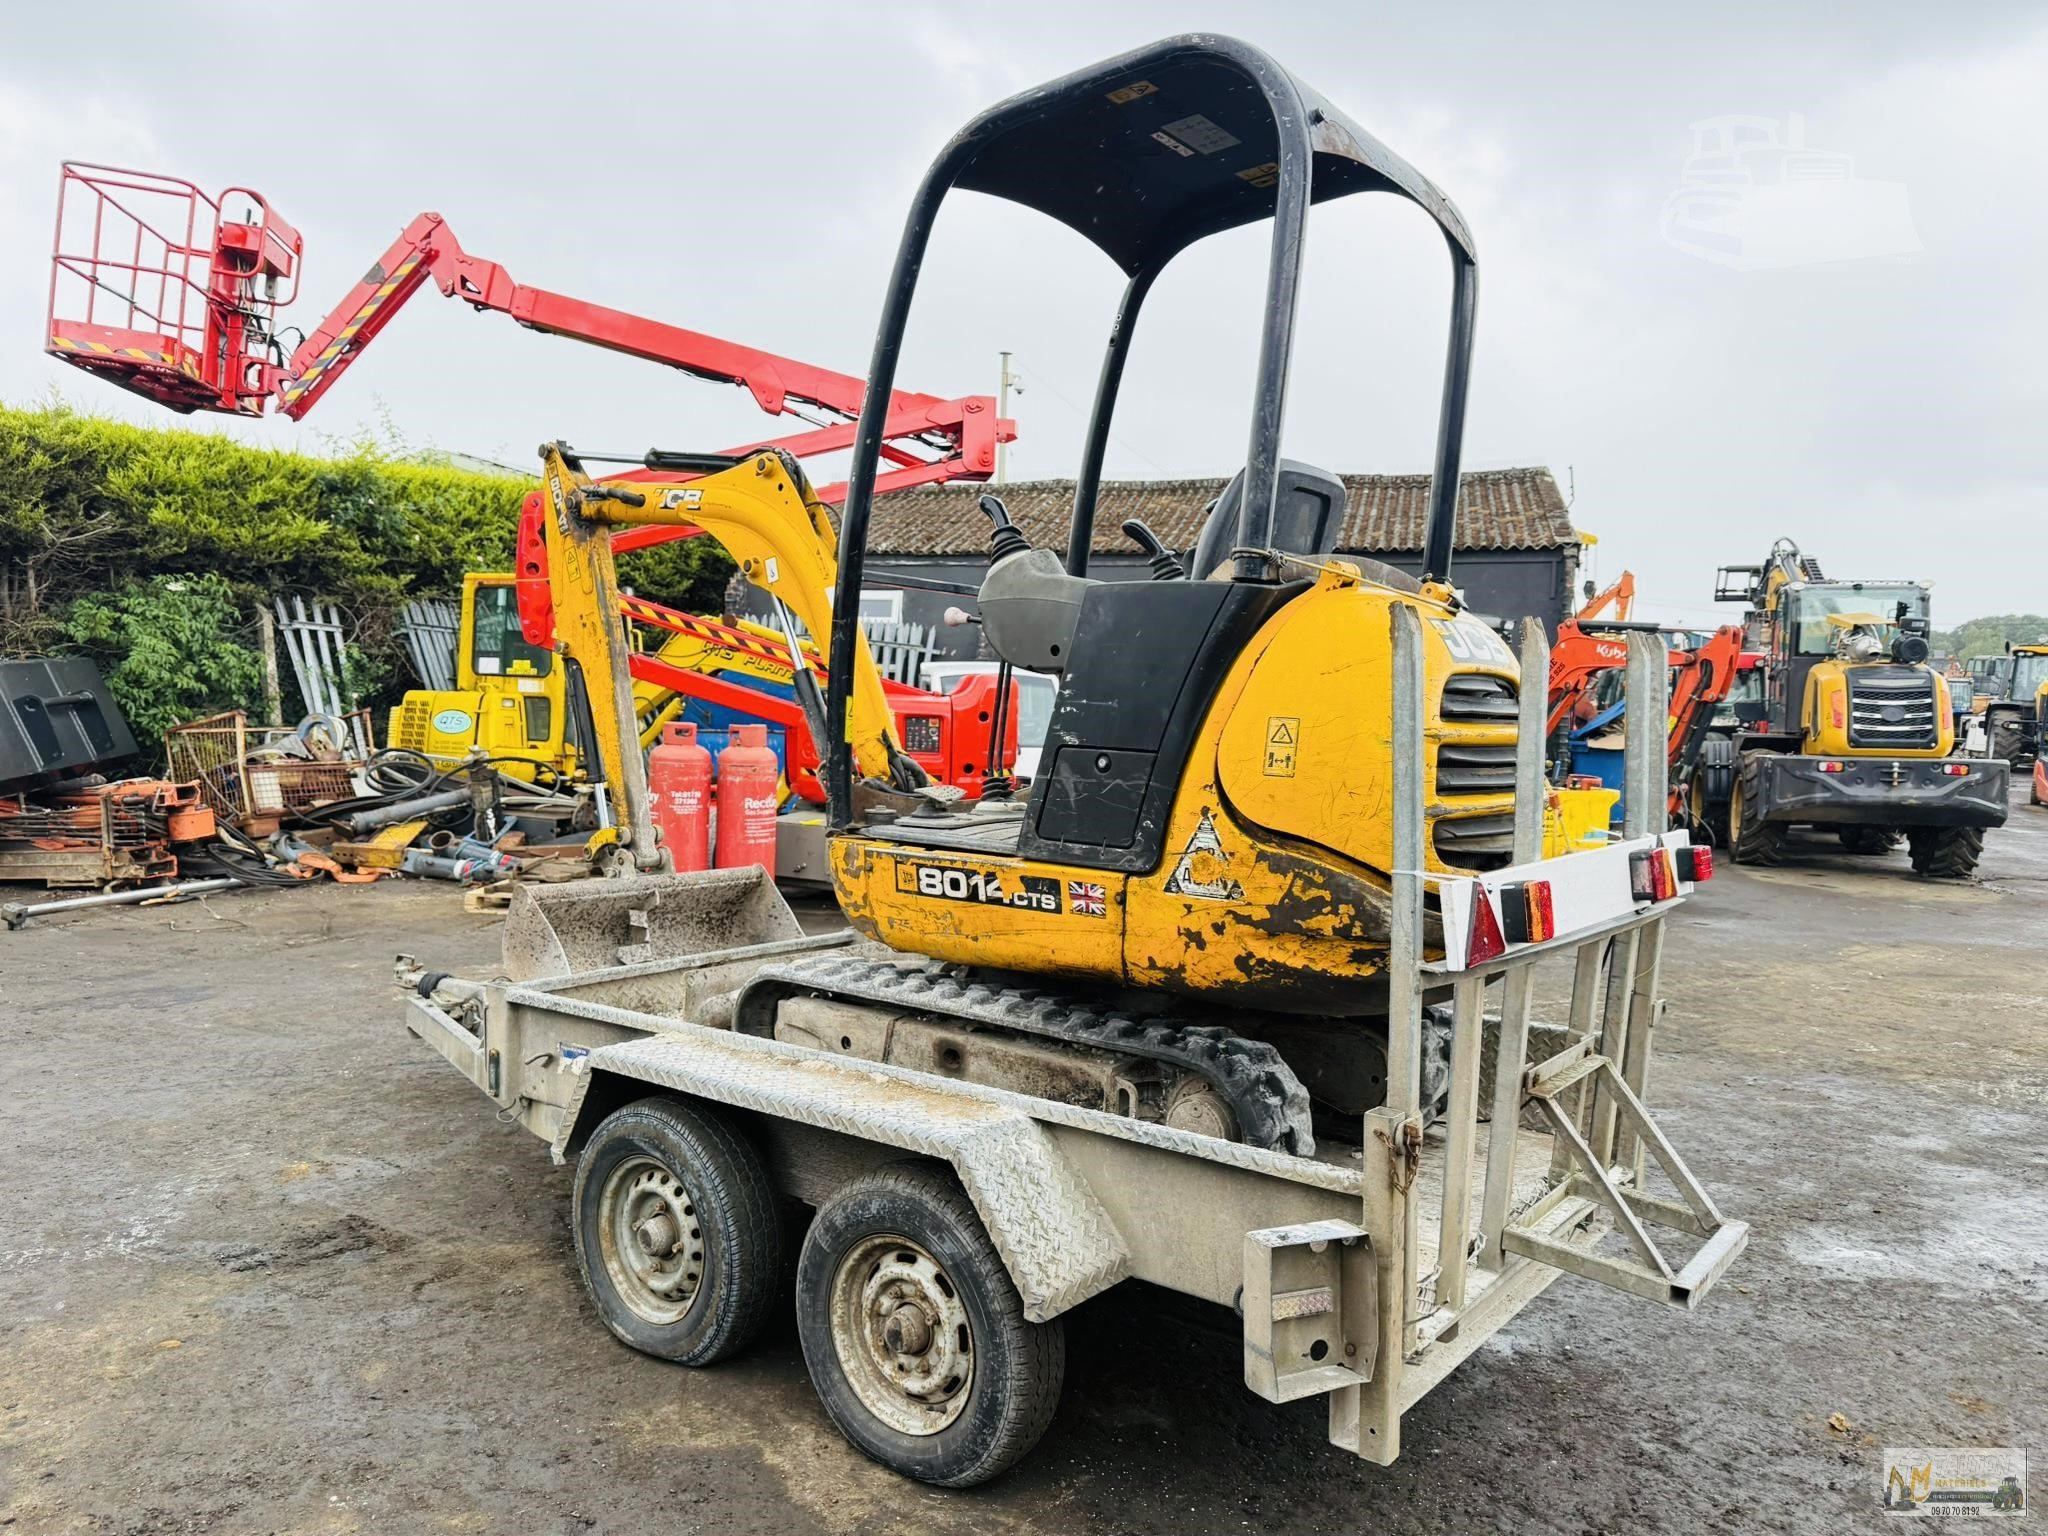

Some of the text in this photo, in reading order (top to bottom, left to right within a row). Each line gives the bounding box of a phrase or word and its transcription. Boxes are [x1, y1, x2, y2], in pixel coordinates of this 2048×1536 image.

[1430, 619, 1510, 662] JCB
[440, 716, 464, 726] QTS
[918, 866, 1056, 910] 8014 CTS
